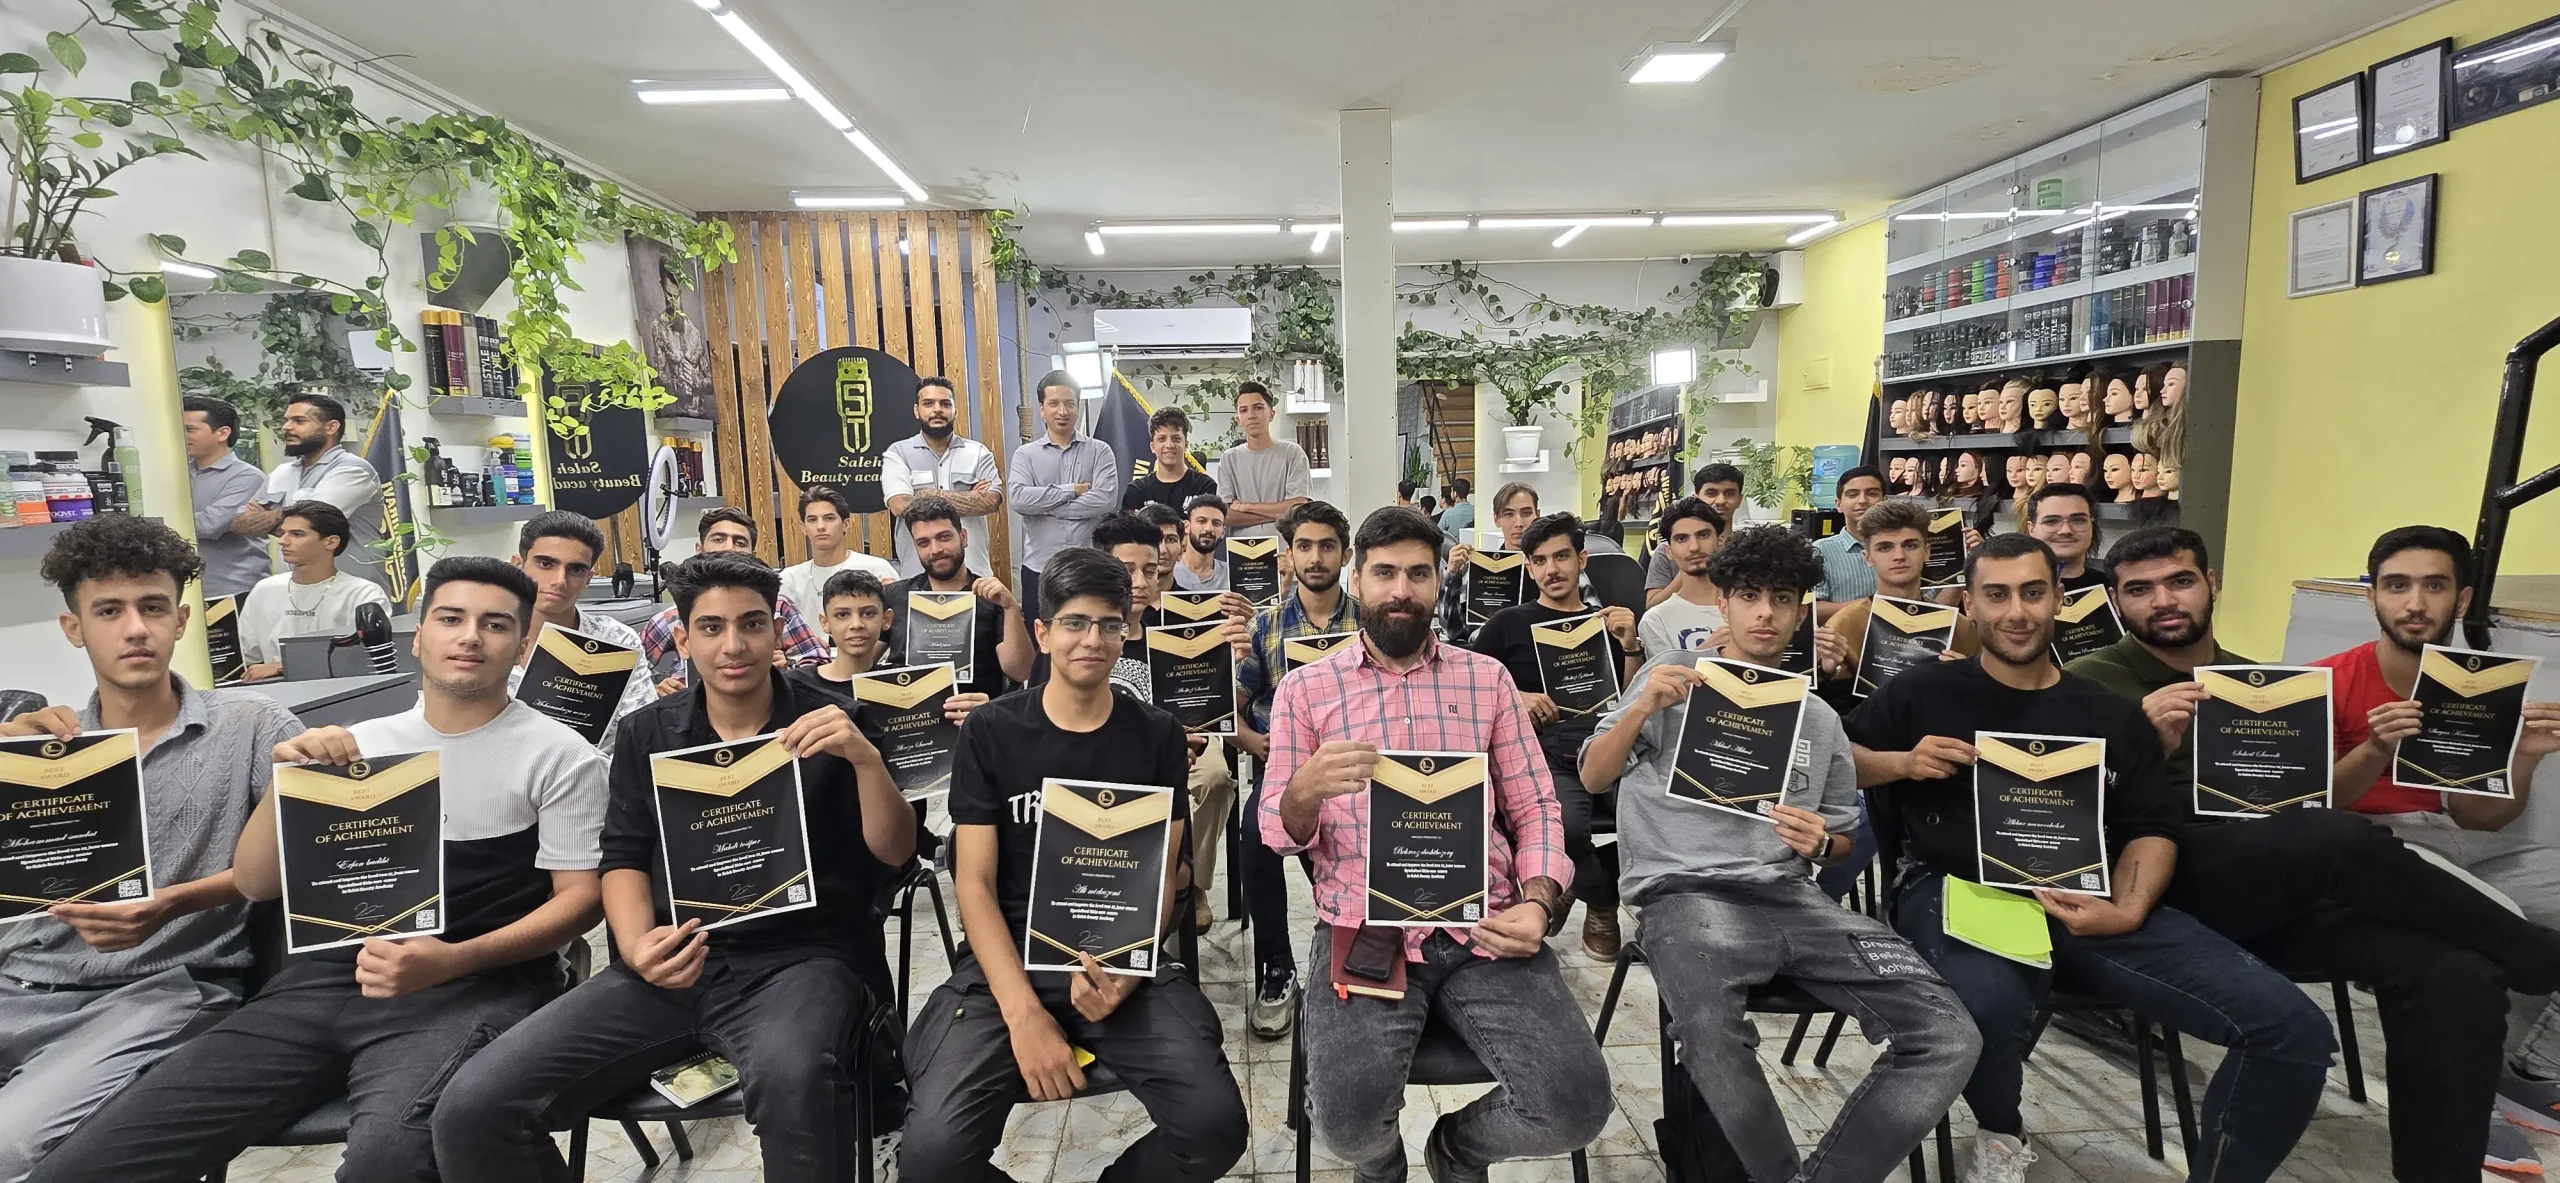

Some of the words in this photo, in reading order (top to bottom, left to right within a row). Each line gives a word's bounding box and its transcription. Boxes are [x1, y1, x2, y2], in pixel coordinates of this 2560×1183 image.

[480, 350, 492, 379] STYLE
[838, 456, 882, 468] Saleh
[801, 470, 852, 487] Beauty
[542, 680, 552, 688] OF
[553, 683, 604, 700] ACHIEVEMENT
[554, 675, 598, 691] CERTIFICATE
[2441, 702, 2487, 711] CERTIFICATE
[2441, 709, 2496, 719] ACHIEVEMENT
[887, 711, 931, 724] CERTIFICATE
[1717, 710, 1765, 727] CERTIFICATE
[2232, 719, 2288, 728] CERTIFICATE
[889, 718, 941, 733] ACHIEVEMENT
[1706, 716, 1716, 724] OF
[1717, 719, 1774, 737] ACHIEVEMENT
[2234, 727, 2301, 737] ACHIEVEMENT
[2009, 787, 2063, 797] CERTIFICATE
[11, 793, 94, 810] CERTIFICATE
[701, 799, 762, 819] CERTIFICATE
[2014, 796, 2075, 807] ACHIEVEMENT
[16, 801, 111, 819] ACHIEVEMENT
[1402, 811, 1452, 820] CERTIFICATE
[329, 816, 399, 832] CERTIFICATE
[690, 821, 704, 831] OF
[706, 806, 775, 828] ACHIEVEMENT
[1392, 821, 1403, 829] OF
[1404, 821, 1463, 830] ACHIEVEMENT
[315, 835, 331, 844] OF
[334, 824, 415, 842] ACHIEVEMENT
[1074, 847, 1129, 858] CERTIFICATE
[1061, 856, 1073, 864] OF
[1075, 857, 1139, 870] ACHIEVEMENT
